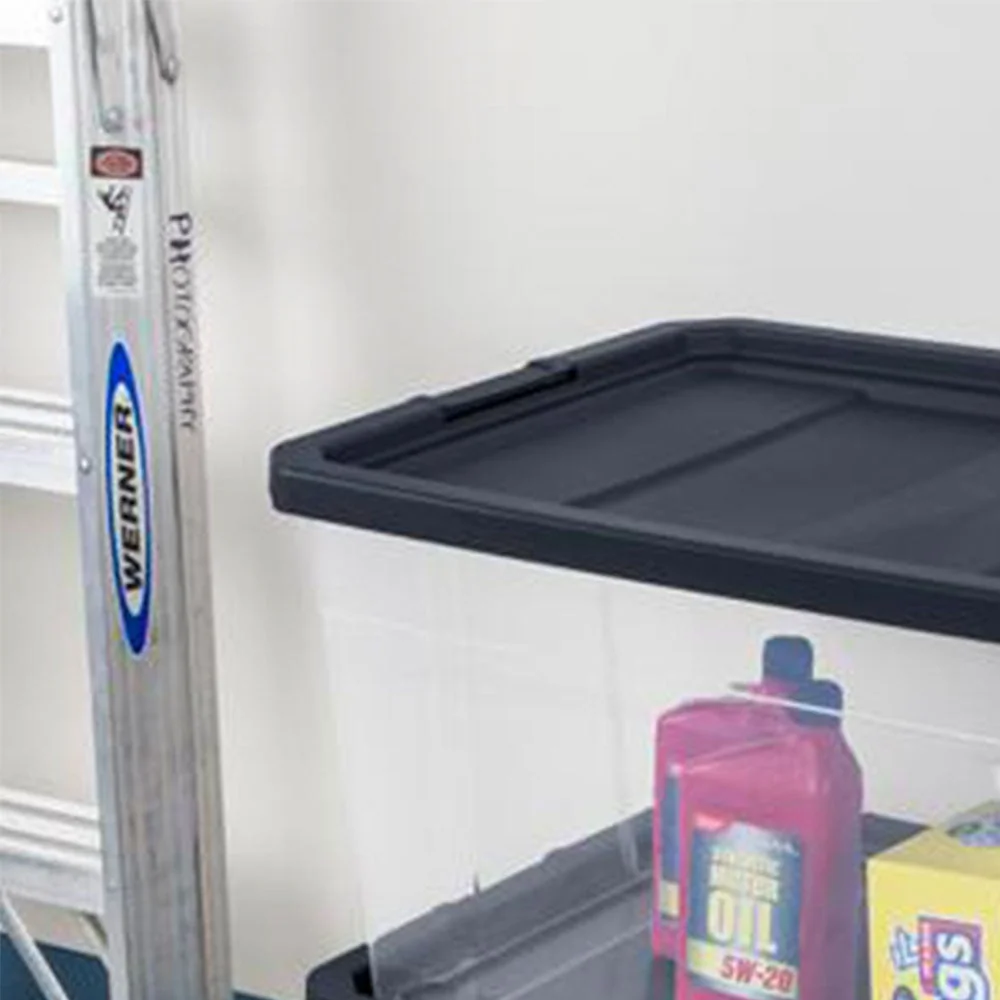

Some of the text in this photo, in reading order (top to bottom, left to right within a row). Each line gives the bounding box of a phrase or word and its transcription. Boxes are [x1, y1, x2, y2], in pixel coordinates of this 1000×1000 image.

[114, 402, 143, 593] WERNER
[706, 888, 779, 956] OIL
[719, 954, 795, 995] 5W-20
